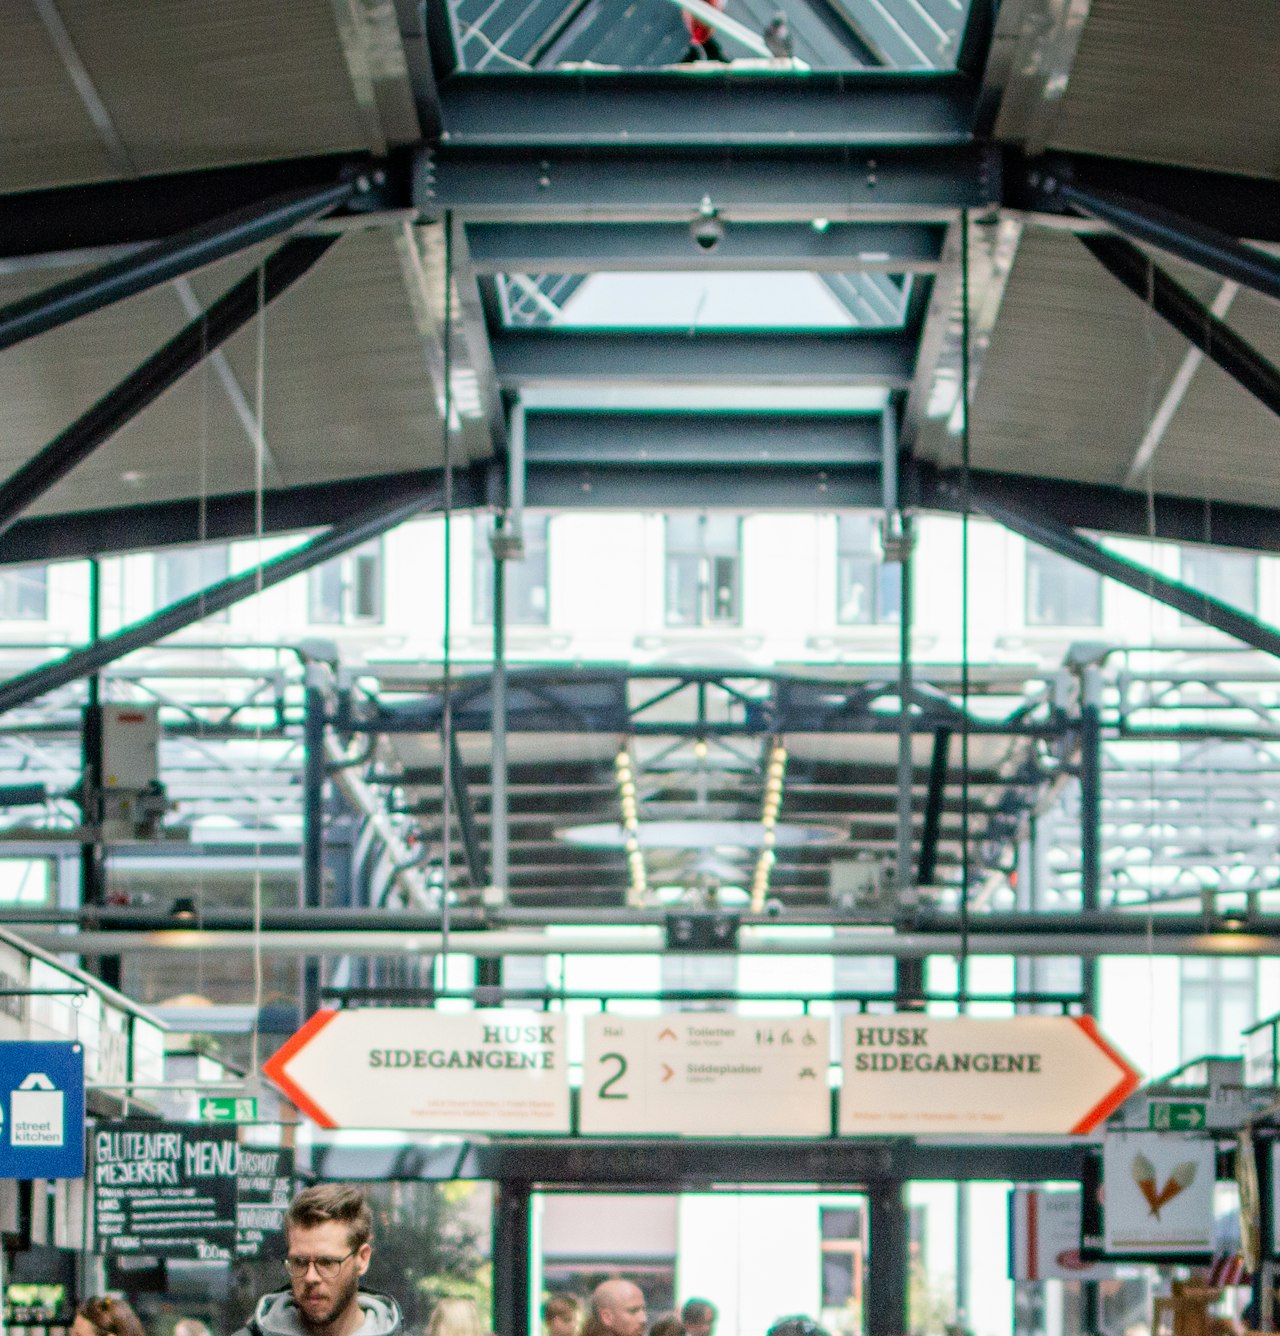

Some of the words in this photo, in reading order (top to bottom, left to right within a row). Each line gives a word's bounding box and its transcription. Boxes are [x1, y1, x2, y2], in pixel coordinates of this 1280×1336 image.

[483, 1026, 555, 1044] HUSK
[856, 1027, 928, 1047] HUSK
[369, 1049, 555, 1069] SIDEGANGENE
[855, 1053, 1042, 1073] SIDEGANGENE
[598, 1053, 628, 1100] 2
[15, 1121, 51, 1132] street
[15, 1131, 61, 1143] kitchen
[96, 1132, 181, 1163] GLUTENFRI
[184, 1140, 240, 1177] MENU
